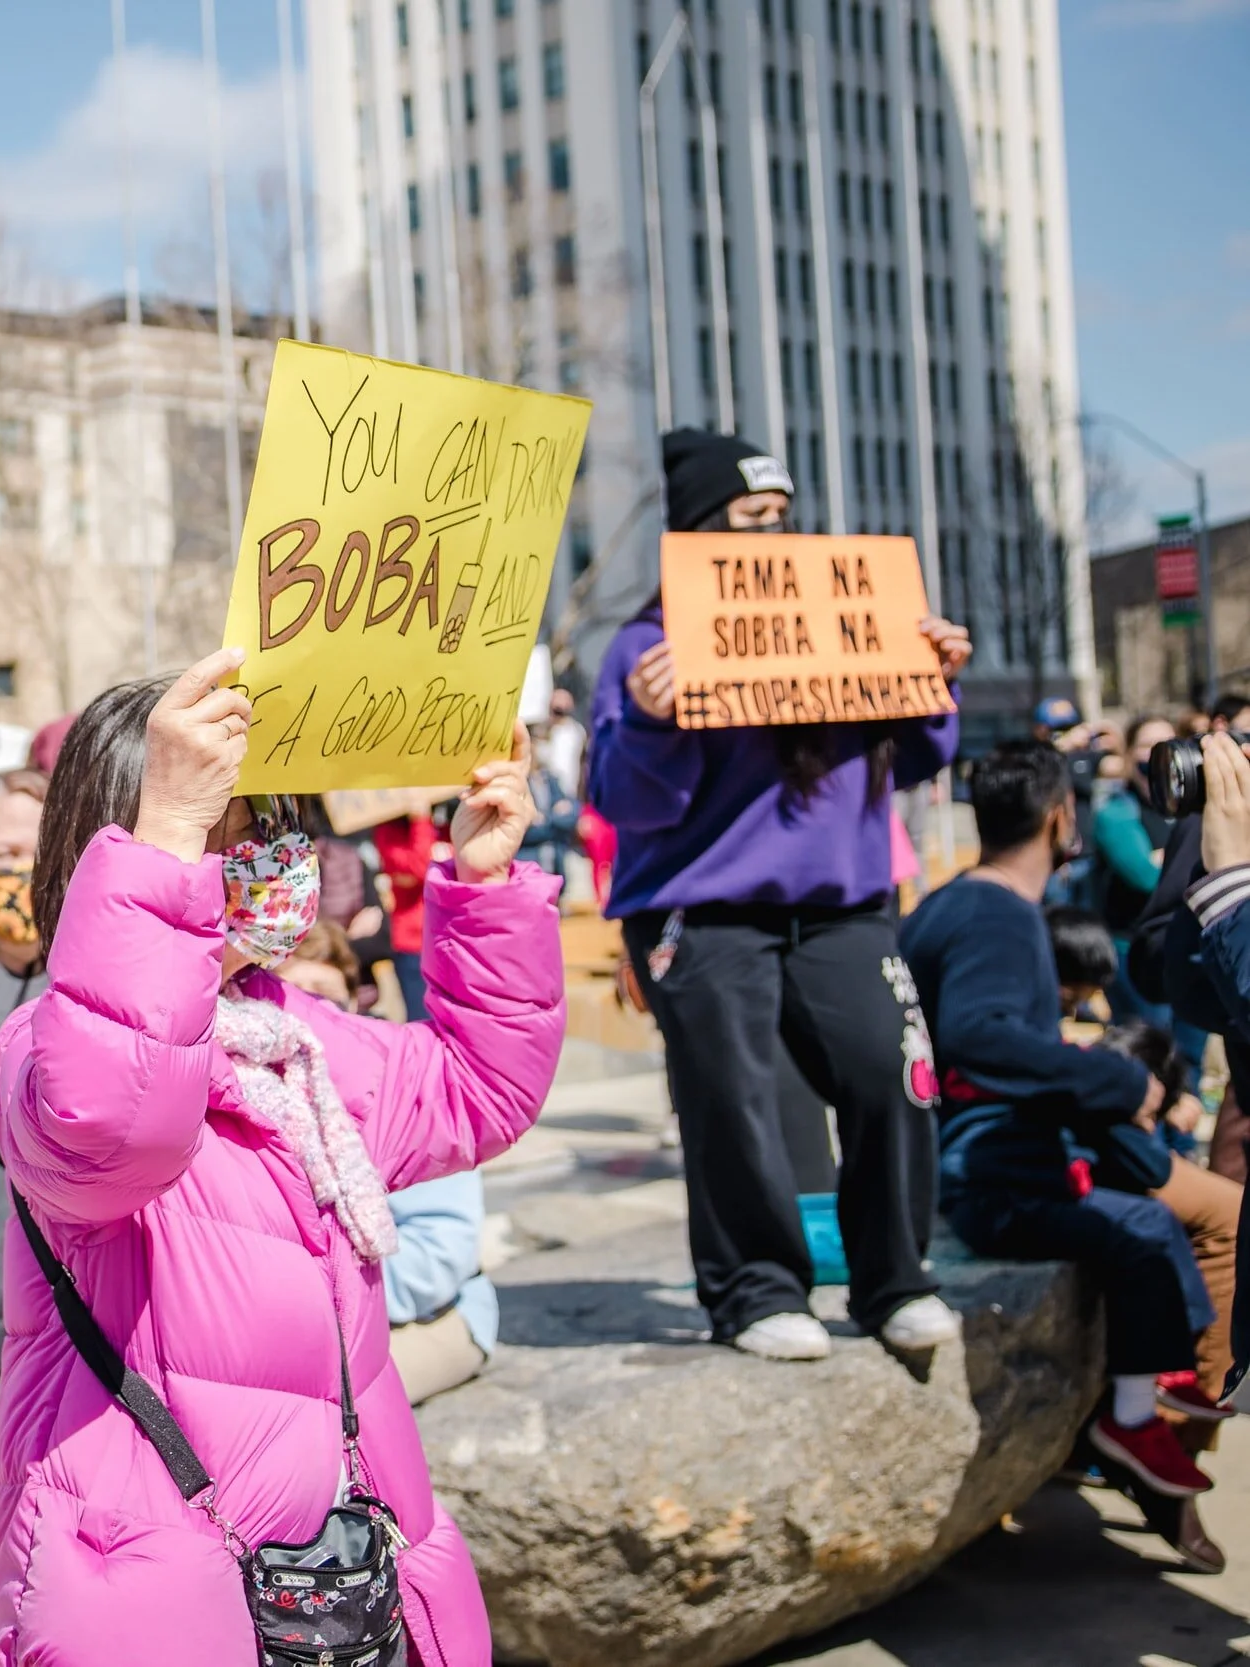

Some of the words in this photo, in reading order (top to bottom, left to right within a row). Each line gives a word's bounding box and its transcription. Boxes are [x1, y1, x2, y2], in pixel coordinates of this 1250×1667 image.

[301, 374, 403, 505] YOU
[425, 416, 505, 504] CAN
[503, 426, 579, 524] DRINK
[258, 515, 441, 653] BOBA
[479, 553, 541, 627] AND
[712, 556, 800, 601] TAMA
[831, 556, 874, 598] NA
[714, 612, 816, 659] SOBRA
[839, 612, 883, 653] NA
[264, 684, 317, 767] A
[321, 675, 407, 758] GOOD
[682, 671, 951, 728] #STOPASIANHATE
